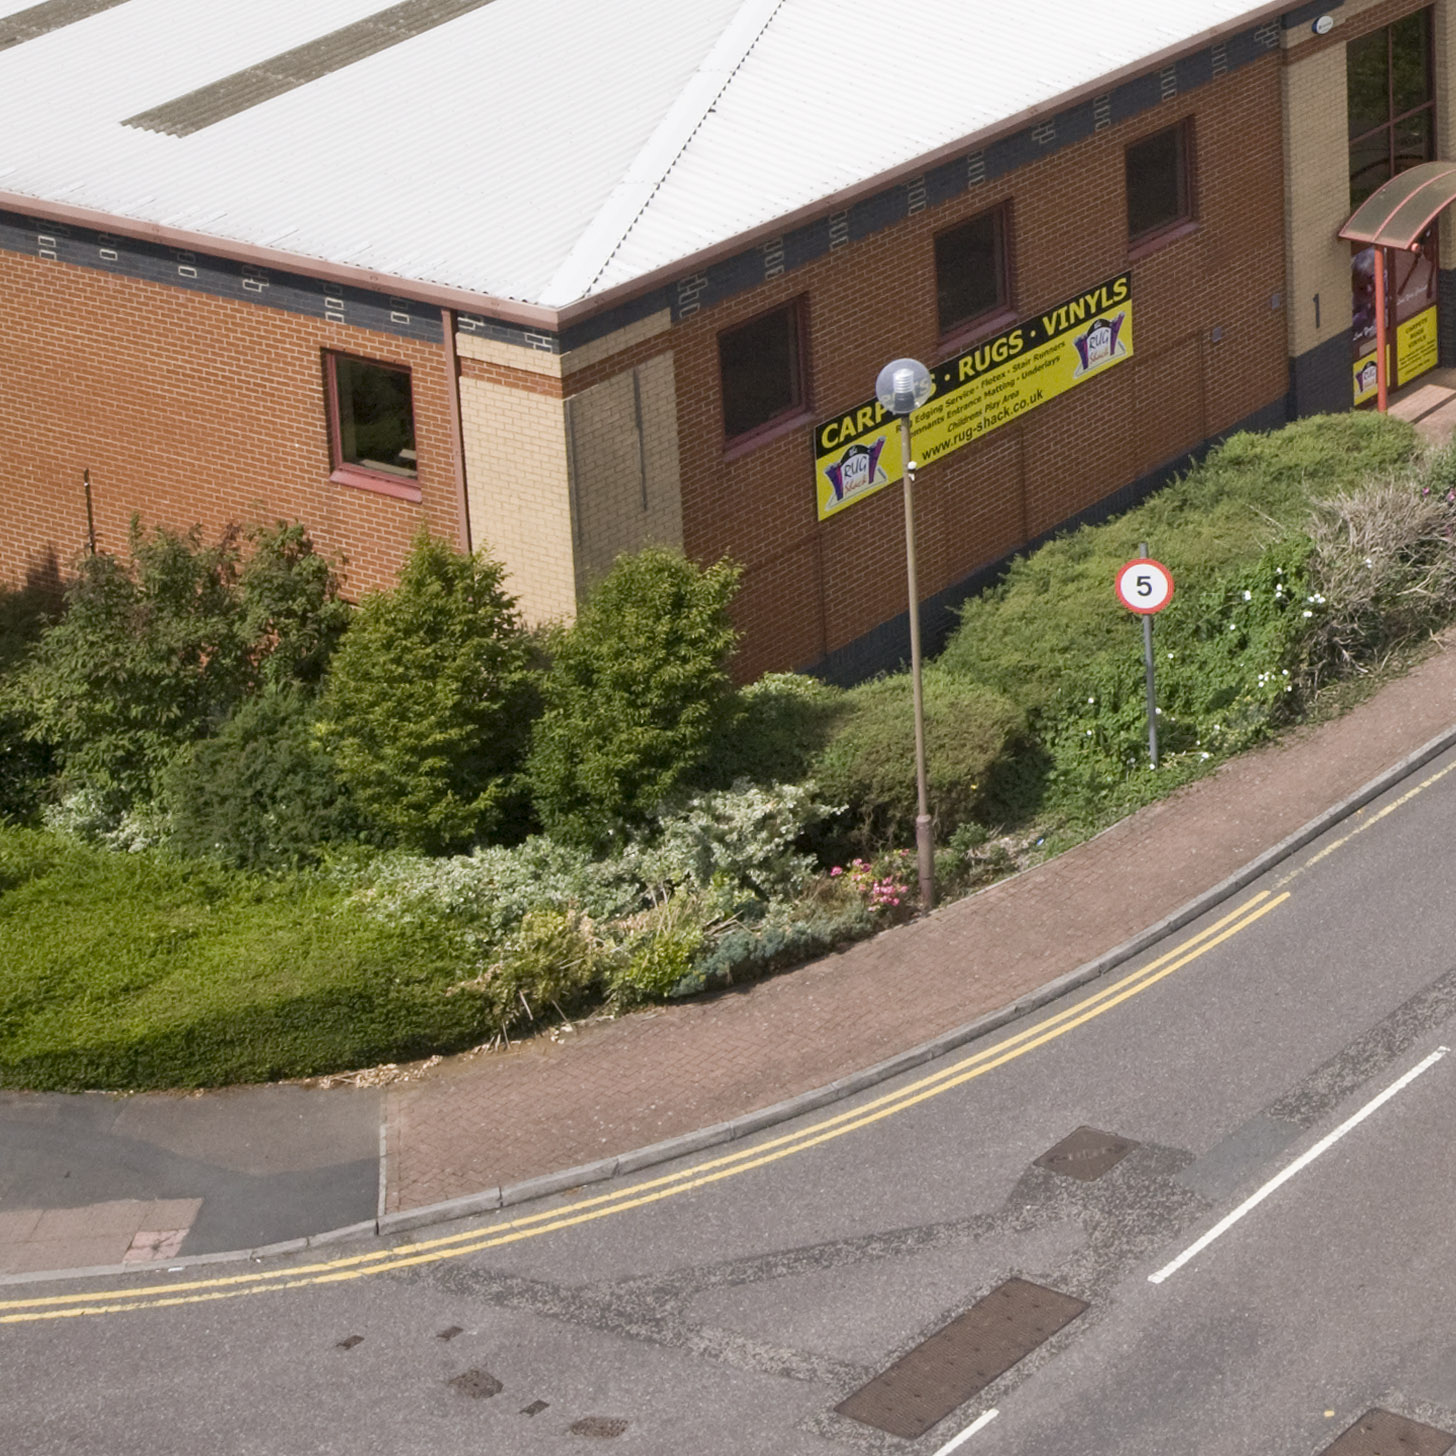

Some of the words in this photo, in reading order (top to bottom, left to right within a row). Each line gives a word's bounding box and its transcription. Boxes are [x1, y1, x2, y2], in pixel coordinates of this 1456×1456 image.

[821, 373, 937, 449] CARPS
[958, 329, 1024, 382] RUGS
[1042, 277, 1128, 336] VINYLS
[914, 403, 944, 424] Edging
[945, 388, 975, 408] Service
[1011, 358, 1031, 373] Stair
[946, 396, 982, 420] Entrance
[983, 378, 1016, 398] Matting
[984, 399, 1000, 414] Play
[1001, 390, 1020, 405] Area
[921, 389, 1044, 461] www.rug-shack.co.uk
[843, 455, 868, 478] RUG
[1136, 576, 1153, 597] 5
